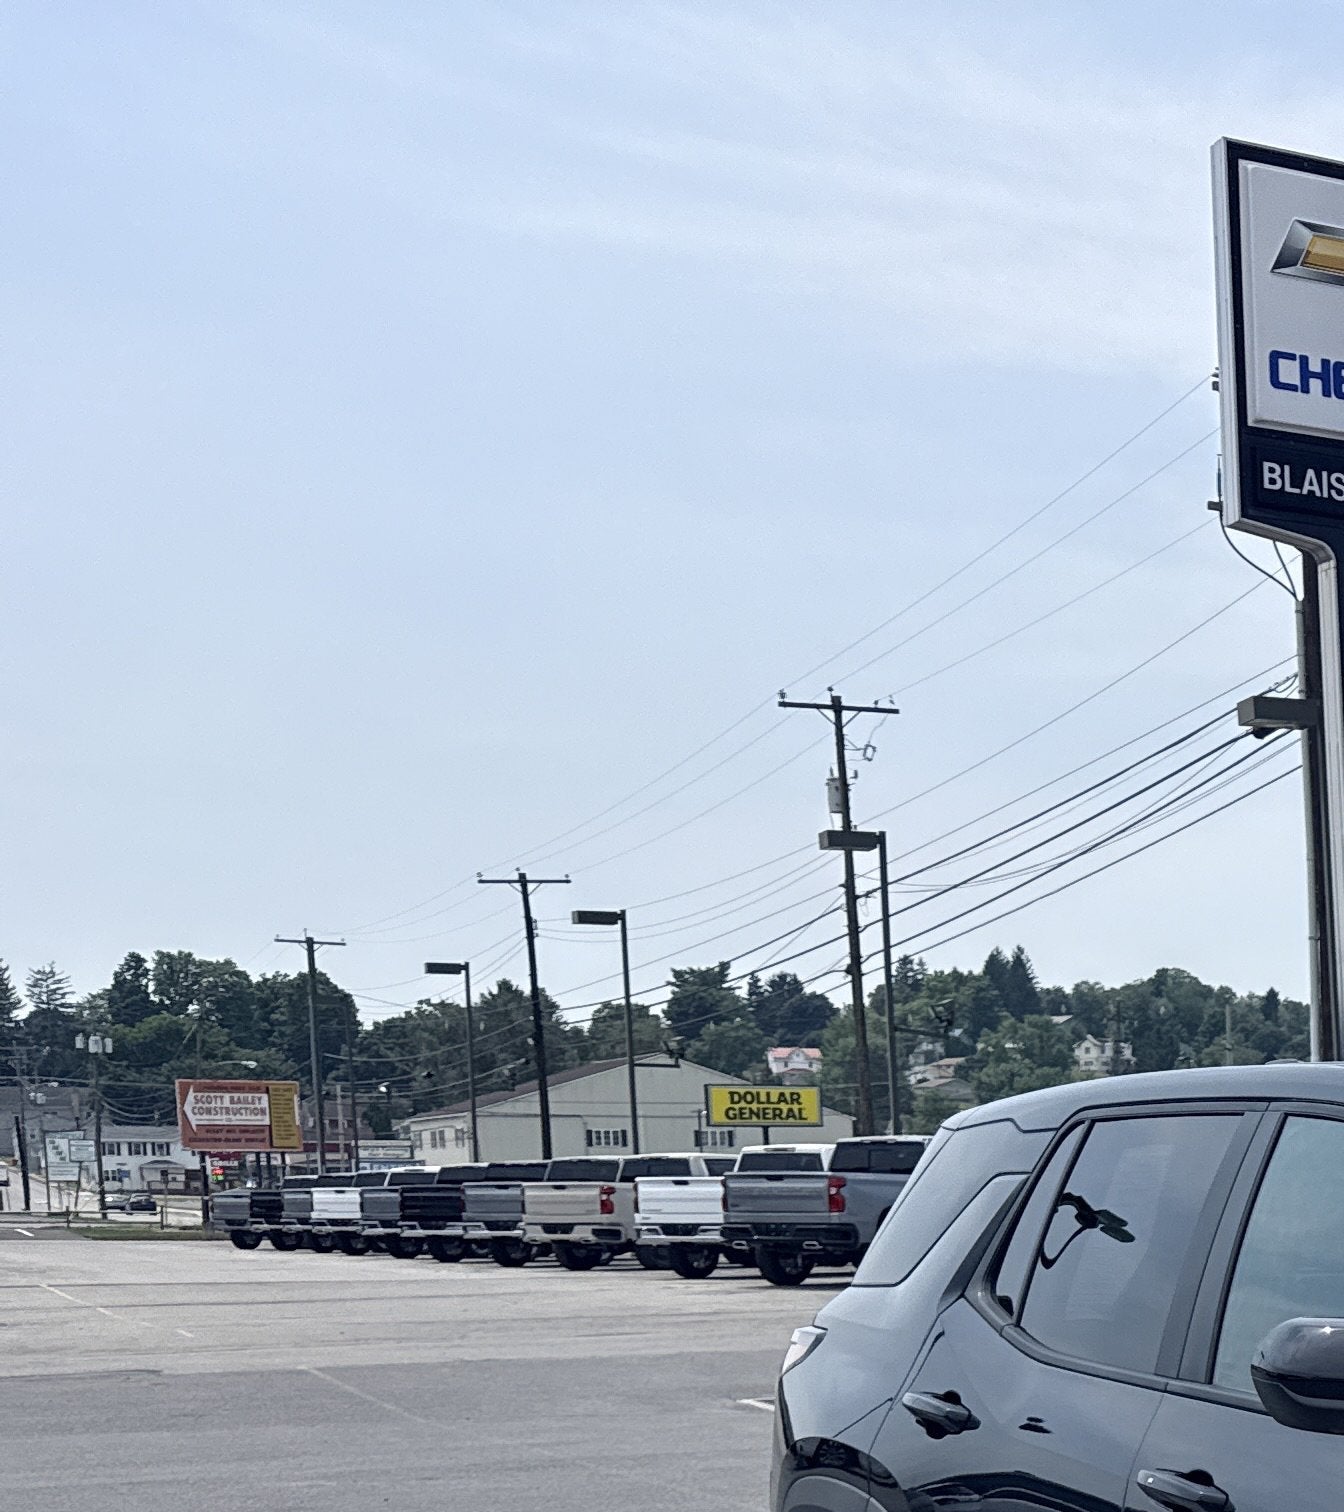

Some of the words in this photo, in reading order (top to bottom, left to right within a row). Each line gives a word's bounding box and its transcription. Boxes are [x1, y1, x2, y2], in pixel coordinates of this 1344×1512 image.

[193, 1094, 224, 1105] SCOTT
[728, 1090, 803, 1106] DOLLAR
[191, 1105, 267, 1117] CONSTRUCTION
[724, 1106, 808, 1121] GENERAL
